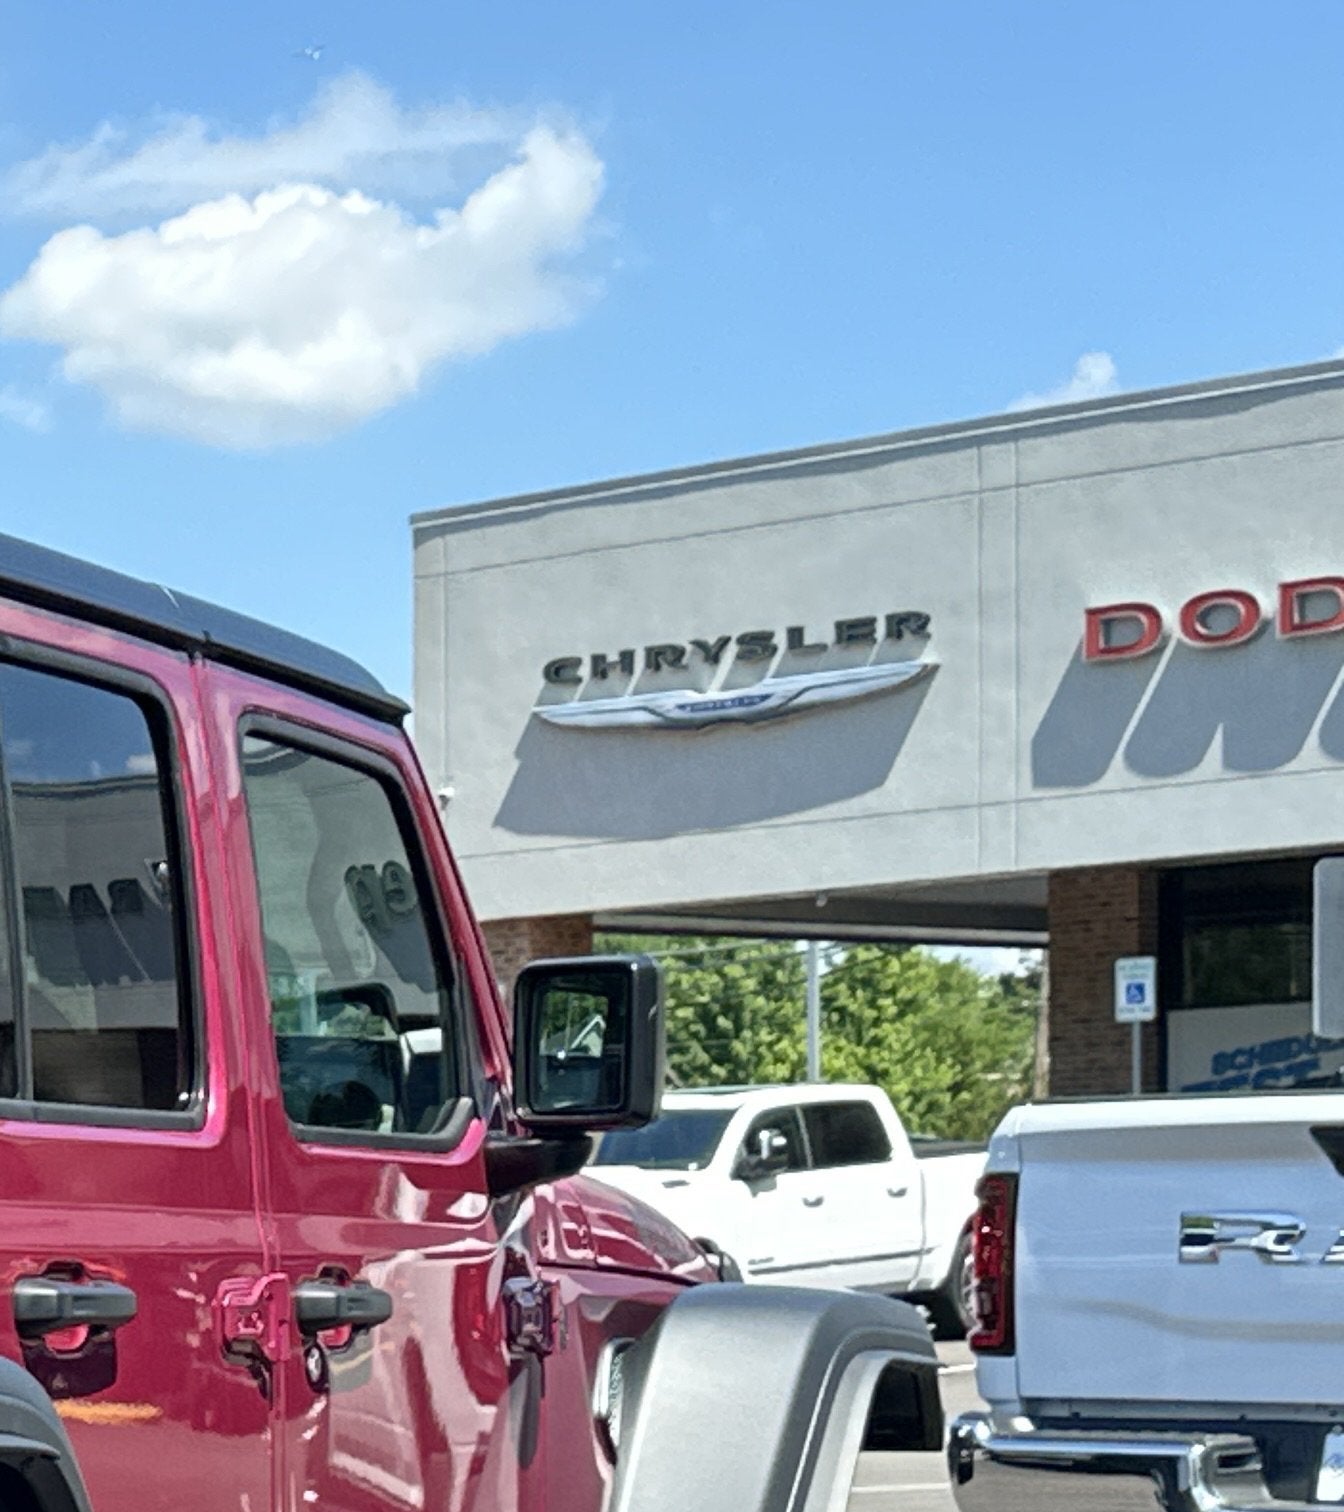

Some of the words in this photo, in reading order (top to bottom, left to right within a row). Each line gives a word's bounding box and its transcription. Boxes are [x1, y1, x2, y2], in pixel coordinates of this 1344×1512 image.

[542, 610, 932, 686] CHRYSLER
[1083, 575, 1344, 662] DOD
[1179, 1209, 1344, 1265] R
